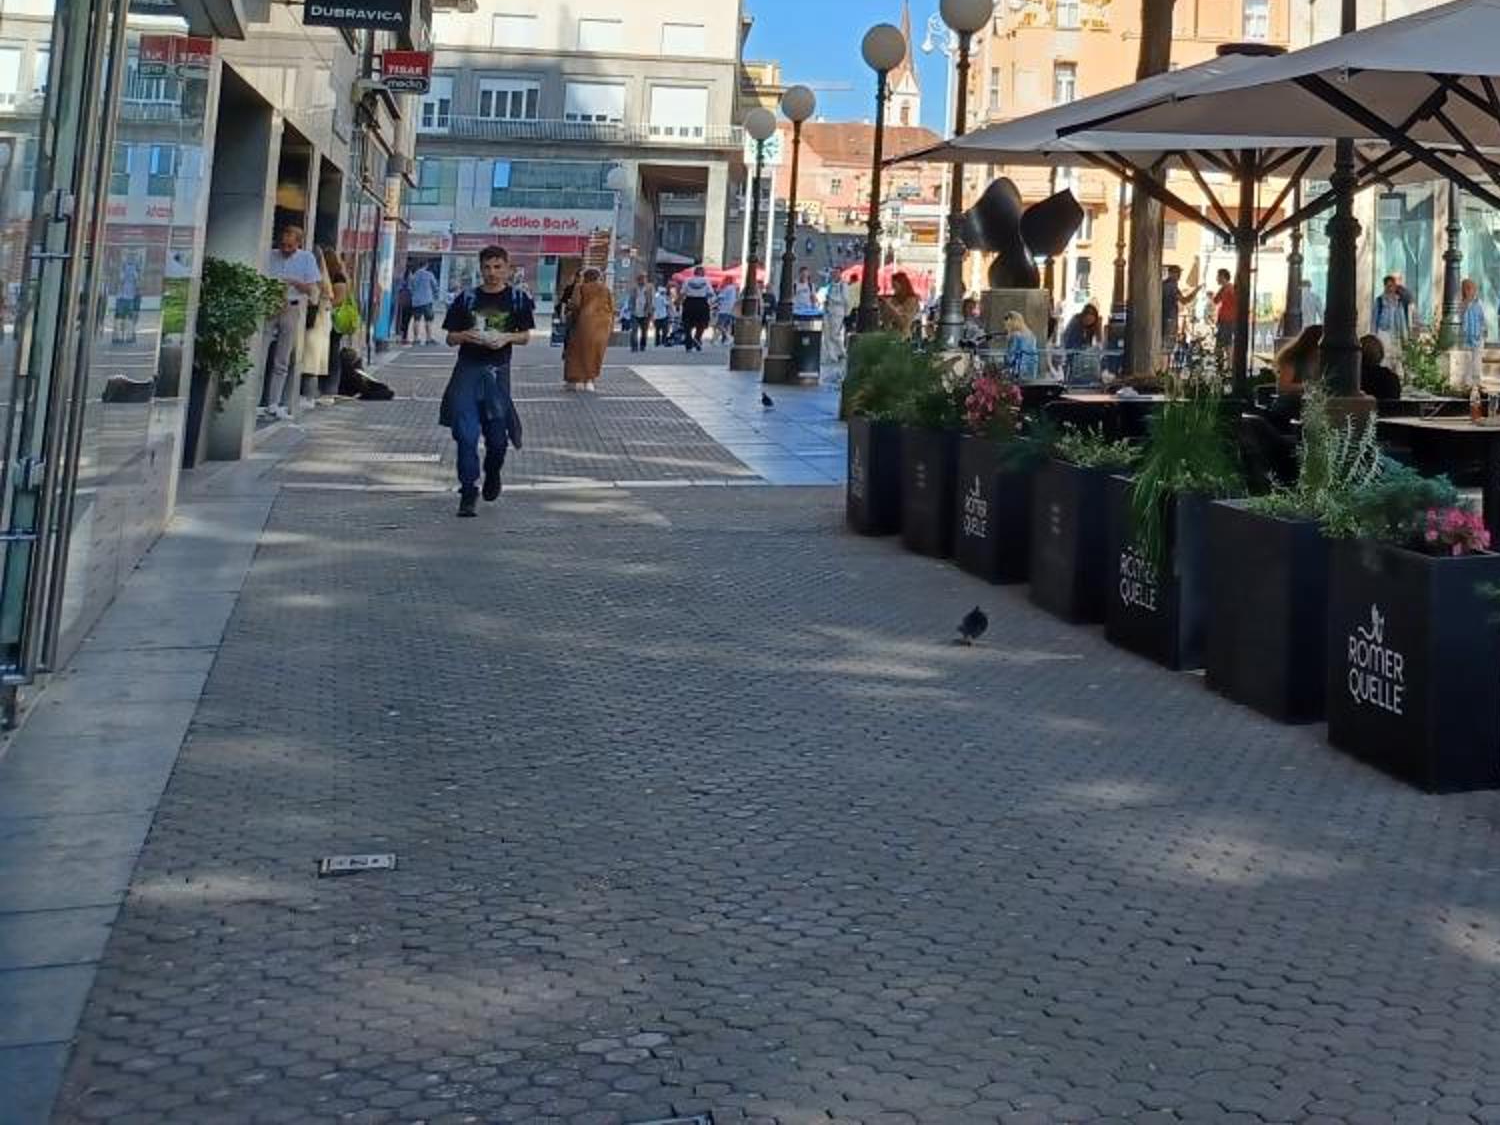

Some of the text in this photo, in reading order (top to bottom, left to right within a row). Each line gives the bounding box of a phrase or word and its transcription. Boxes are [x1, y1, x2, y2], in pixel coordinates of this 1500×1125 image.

[311, 5, 403, 22] DUBRAVICA
[489, 215, 580, 230] Addiko Bank
[1349, 667, 1403, 715] QUELLE
